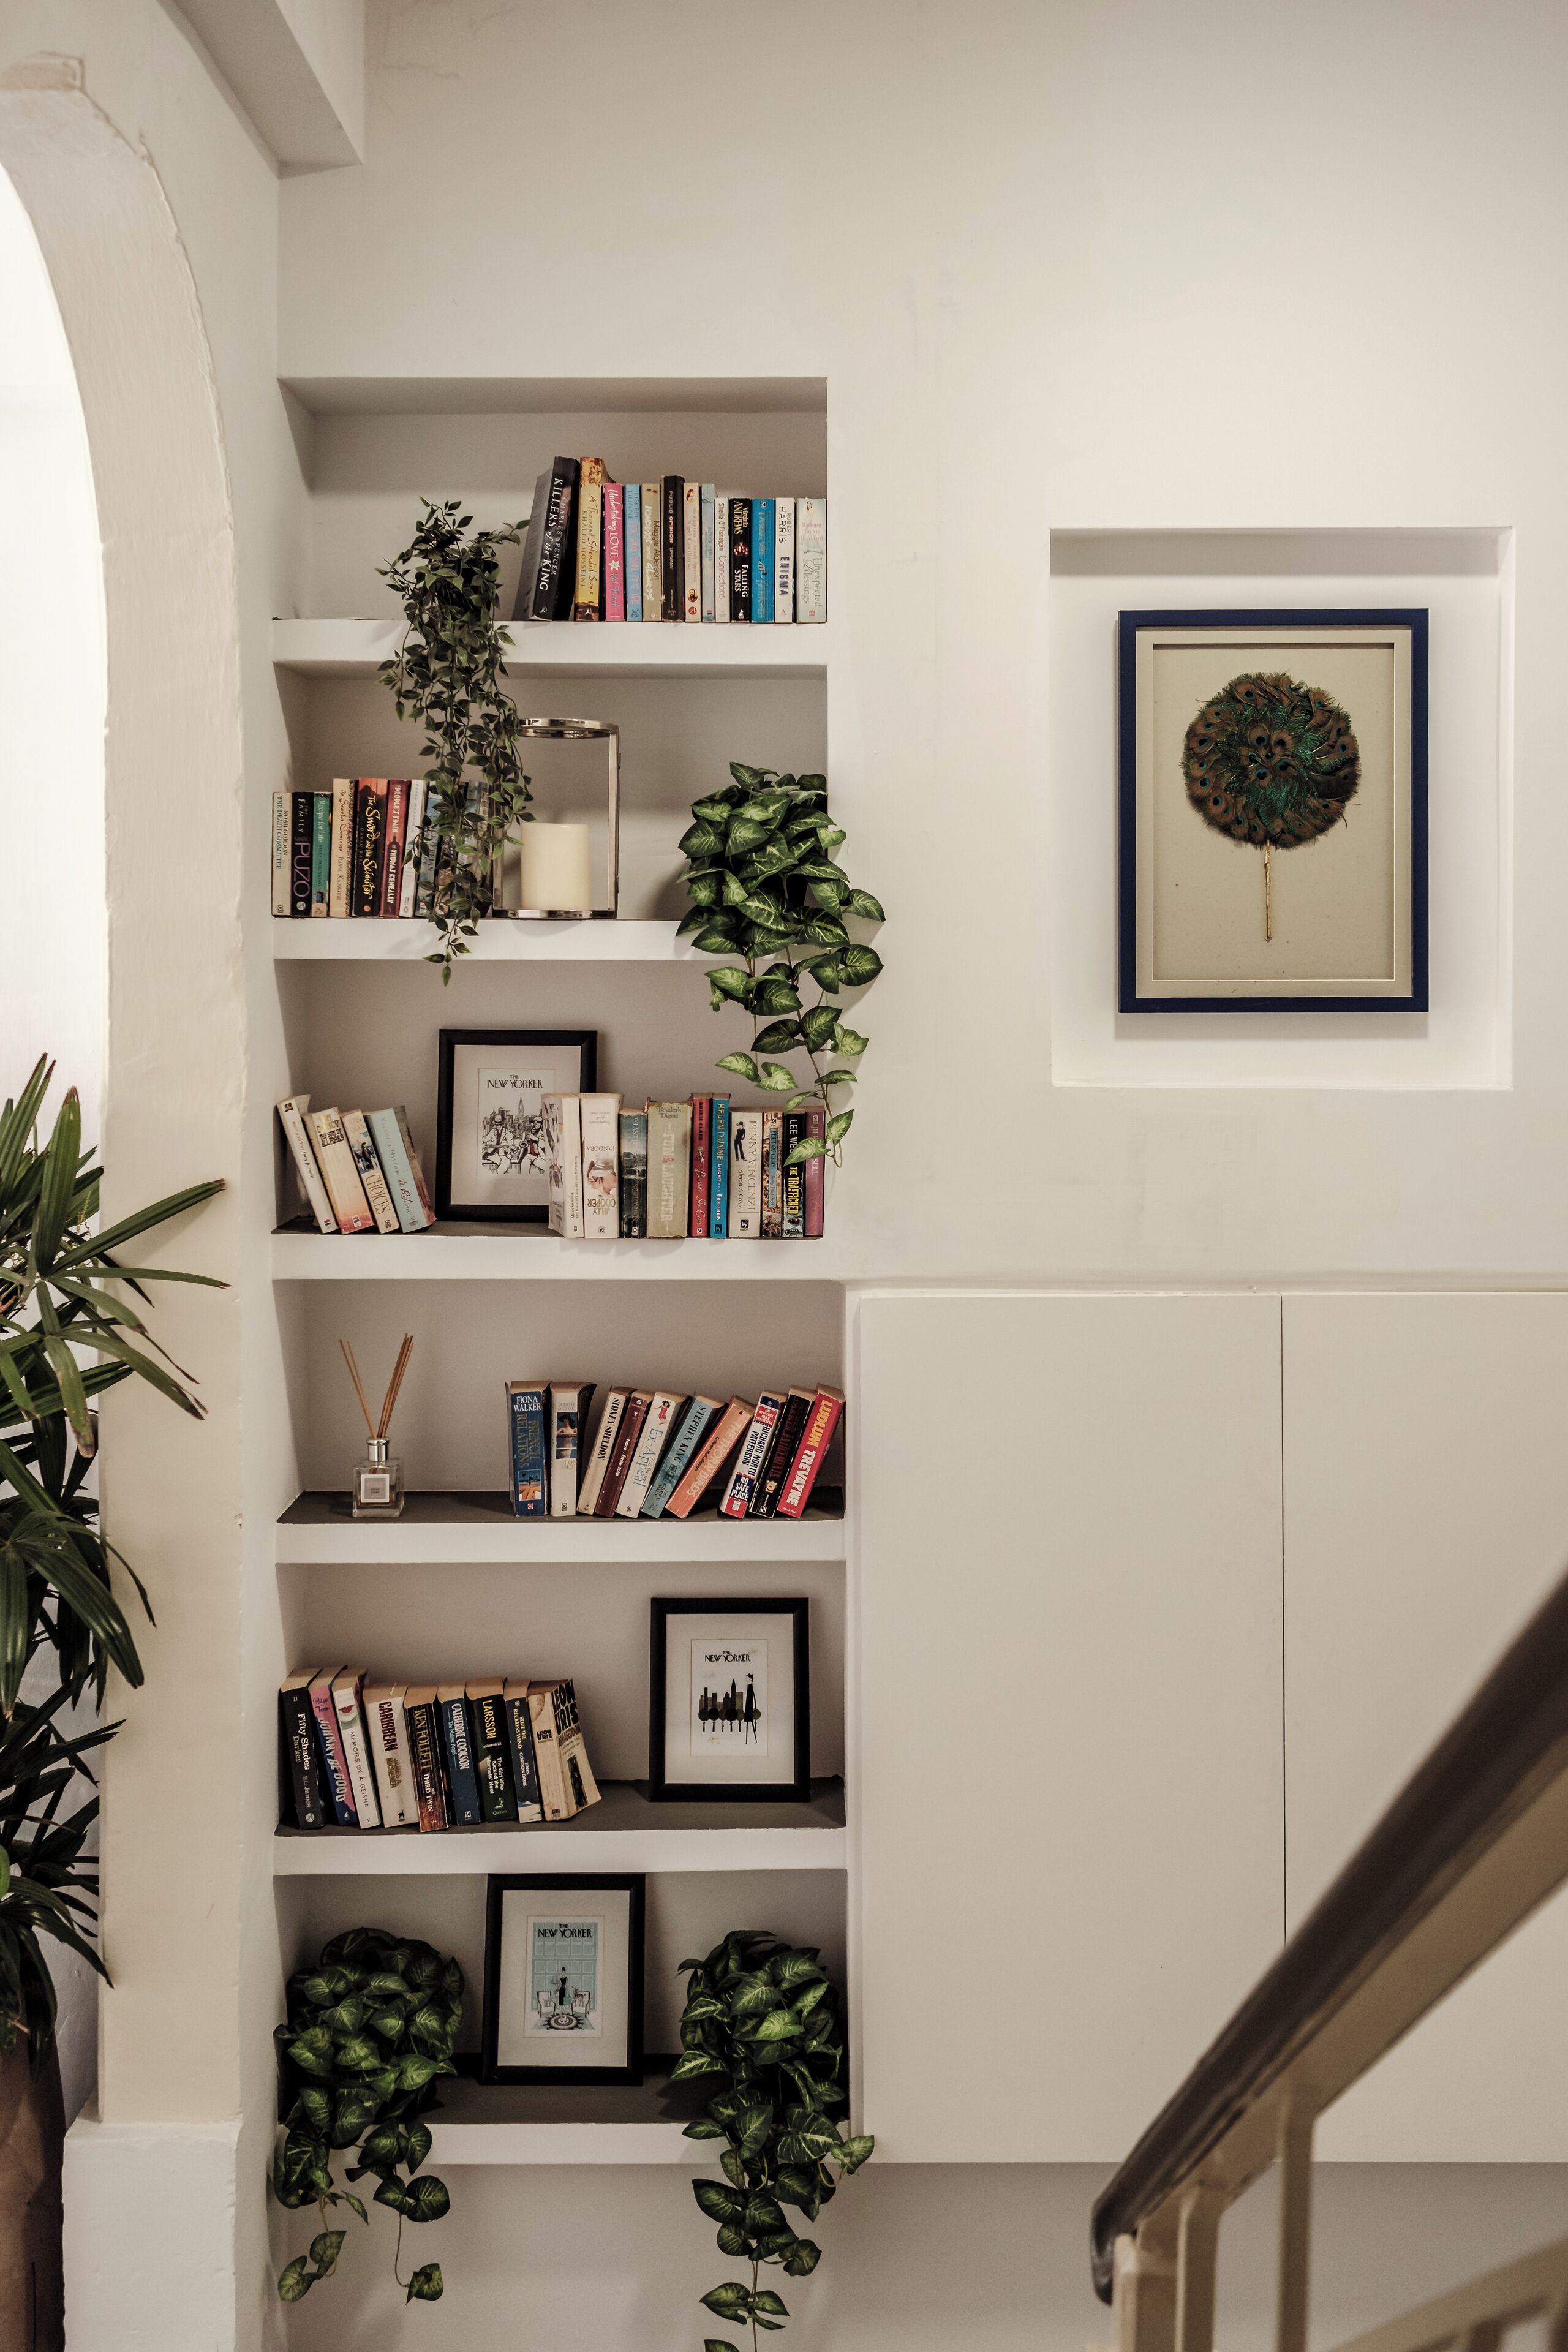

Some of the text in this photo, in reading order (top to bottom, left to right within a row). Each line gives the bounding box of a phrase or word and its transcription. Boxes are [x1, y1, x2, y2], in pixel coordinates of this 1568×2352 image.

[540, 478, 564, 591] KILLERS of the KING
[551, 497, 567, 575] CHARLES SPENCER
[608, 489, 622, 558] Undertaking LOVE
[652, 521, 660, 547] Maggie
[734, 500, 744, 535] ANDREWS
[587, 494, 598, 594] A Thousand Splendid Suns
[718, 556, 726, 599] Connections
[779, 557, 790, 595] ENIGMA
[801, 559, 815, 603] Blessings
[812, 557, 823, 607] Unexpected
[316, 800, 326, 820] Recipe
[367, 796, 376, 807] The
[366, 807, 381, 841] Sword
[293, 842, 311, 897] PUZO
[361, 858, 377, 900] Scimitar
[387, 873, 396, 904] KENEALLY
[488, 1079, 544, 1088] NEW YORKER
[663, 1133, 675, 1156] FUN
[381, 1117, 391, 1147] Victoria
[389, 1149, 399, 1174] Hislop
[400, 1189, 413, 1214] Return
[747, 1158, 756, 1210] VINCENZI
[365, 1174, 391, 1215] CHOICES
[587, 1198, 616, 1207] COOPER
[661, 1164, 674, 1222] LAUGHTER
[788, 1177, 799, 1215] TRAFFICKED
[513, 1403, 541, 1412] WALKER
[516, 1395, 538, 1404] FIONA
[517, 1413, 529, 1468] RELATIONS
[528, 1420, 540, 1460] FRENCH
[597, 1398, 620, 1461] SIDNEY SHELDON
[674, 1405, 707, 1463] STEPHEN KING
[709, 1436, 719, 1450] Colleen
[807, 1400, 833, 1447] LUDLUM
[633, 1428, 663, 1487] Ex-Appeal
[687, 1422, 742, 1497] THE THORN BIRDS
[742, 1431, 760, 1466] PATTERSON
[748, 1426, 770, 1476] RICHARD NORTH
[731, 1490, 748, 1501] PLACE
[736, 1483, 749, 1493] SAFE
[786, 1449, 816, 1506] TREVAYNE
[551, 1679, 576, 1714] LEON
[379, 1701, 398, 1752] CARIBBEAN
[483, 1700, 497, 1740] LARSSON
[554, 1702, 579, 1735] URIS
[301, 1738, 311, 1770] Shades
[350, 1732, 360, 1762] MEMOIRS
[356, 1765, 363, 1774] OF
[415, 1709, 432, 1770] KEN FOLLETT
[456, 1739, 469, 1770] COOKSON
[318, 1718, 347, 1802] JOHNNY BE GOOD
[386, 1757, 397, 1789] MICHENER
[538, 1929, 592, 1938] NEW YORKER
